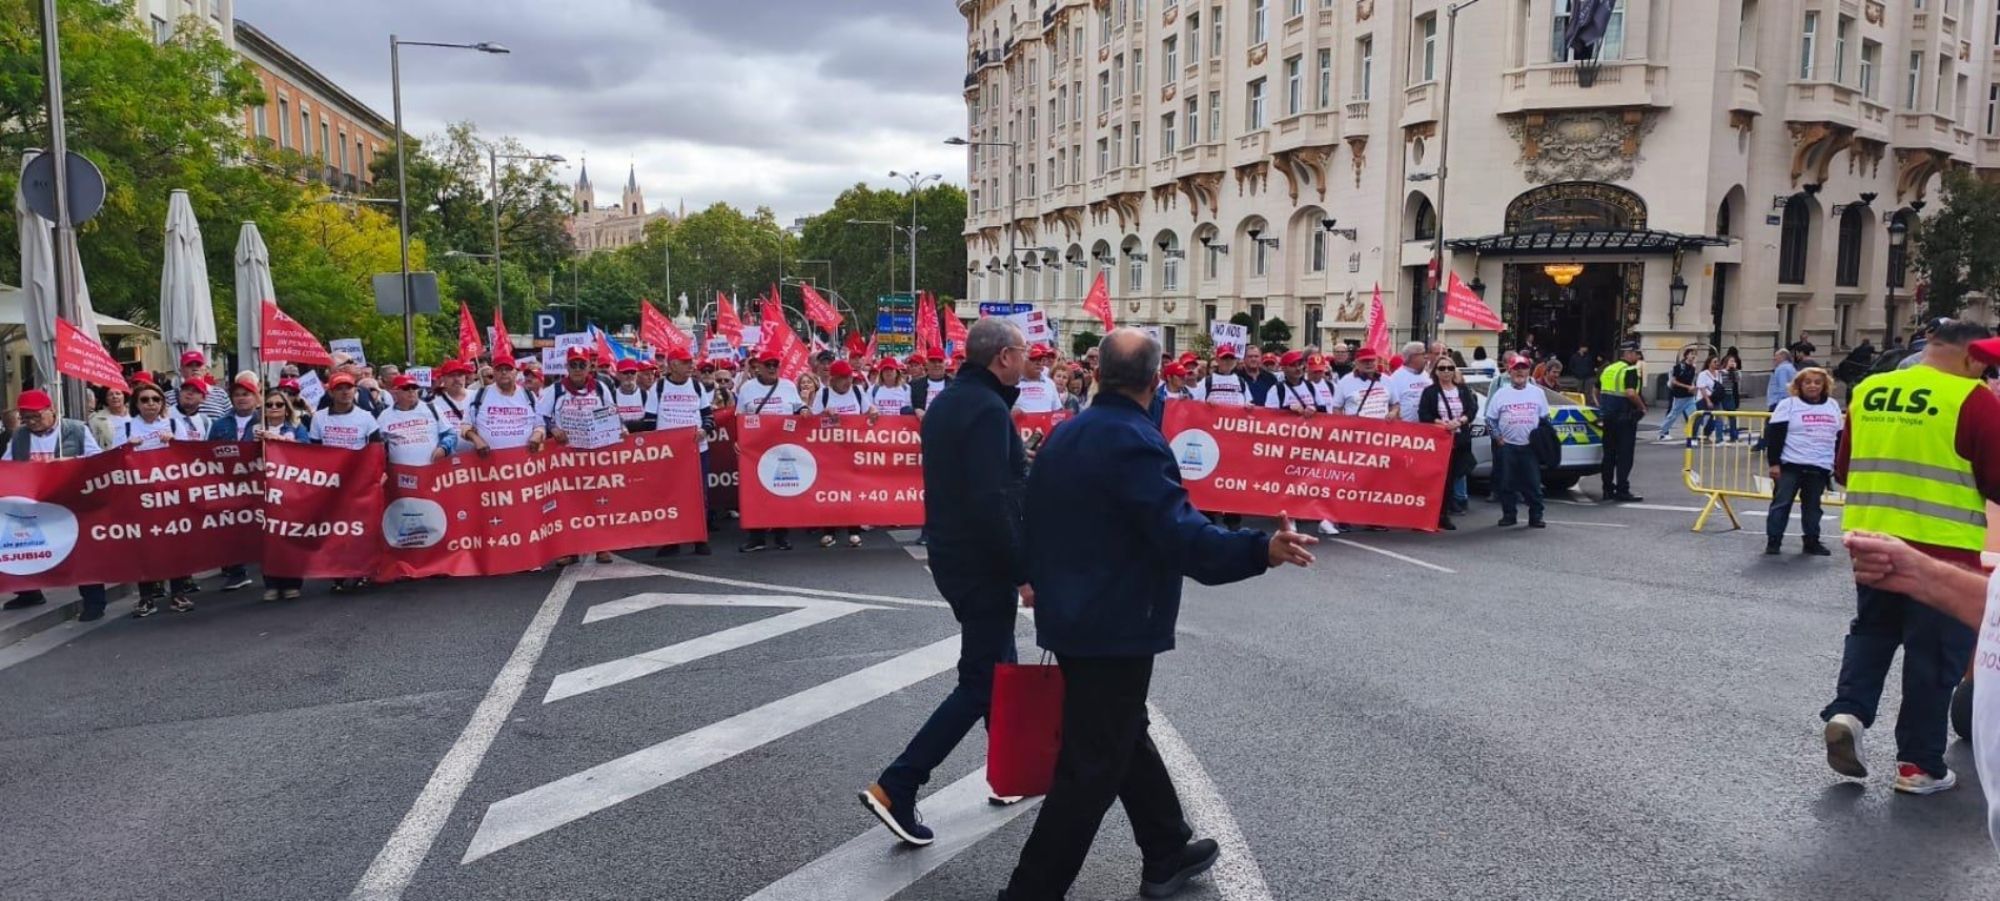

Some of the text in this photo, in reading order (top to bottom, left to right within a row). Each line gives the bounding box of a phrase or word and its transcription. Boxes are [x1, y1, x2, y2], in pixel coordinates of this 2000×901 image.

[538, 314, 556, 338] P
[806, 428, 922, 444] JUBILACIÓN
[1212, 416, 1436, 451] JUBILACIÓN ANTICIPADA
[431, 444, 674, 492] JUBILACIÓN ANTICIPADA
[854, 451, 886, 465] SIN
[1253, 442, 1391, 469] SIN PENALIZAR
[80, 458, 225, 494] JUBILACIÓN
[1284, 464, 1356, 483] CATALUNYA
[140, 489, 180, 508] SIN
[480, 473, 626, 507] SIN PENALIZAR
[815, 490, 852, 503] CON
[858, 490, 888, 501] +40
[1214, 477, 1426, 507] CON +40 AÑOS COTIZADOS
[91, 523, 142, 541] CON
[150, 517, 192, 536] +40
[202, 508, 265, 530] AÑOS
[447, 506, 679, 552] CON +40 AÑOS COTIZADOS
